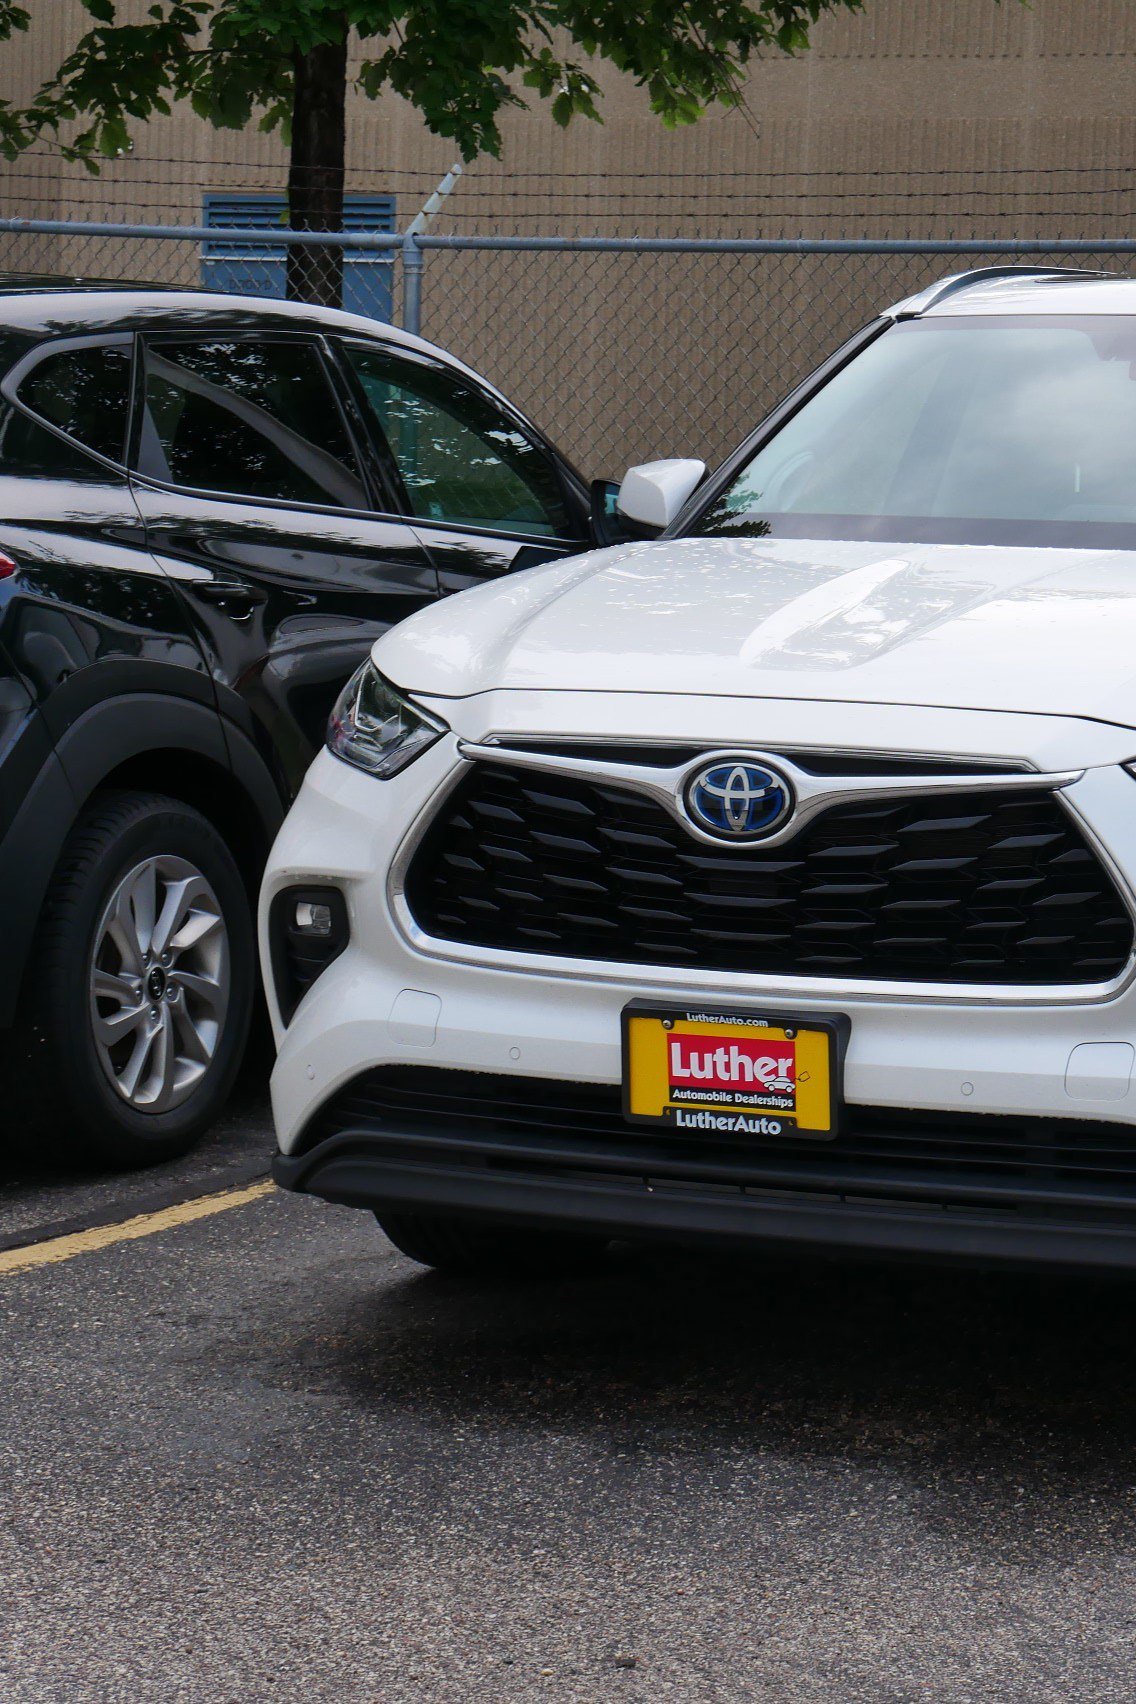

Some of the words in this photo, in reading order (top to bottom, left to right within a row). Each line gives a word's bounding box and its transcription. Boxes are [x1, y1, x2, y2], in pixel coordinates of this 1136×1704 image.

[686, 1012, 769, 1027] LutherAuto.com
[671, 1042, 793, 1082] Luther
[673, 1088, 732, 1102] Automobile
[735, 1093, 794, 1107] Dealerships
[676, 1109, 782, 1135] LutherAuto
